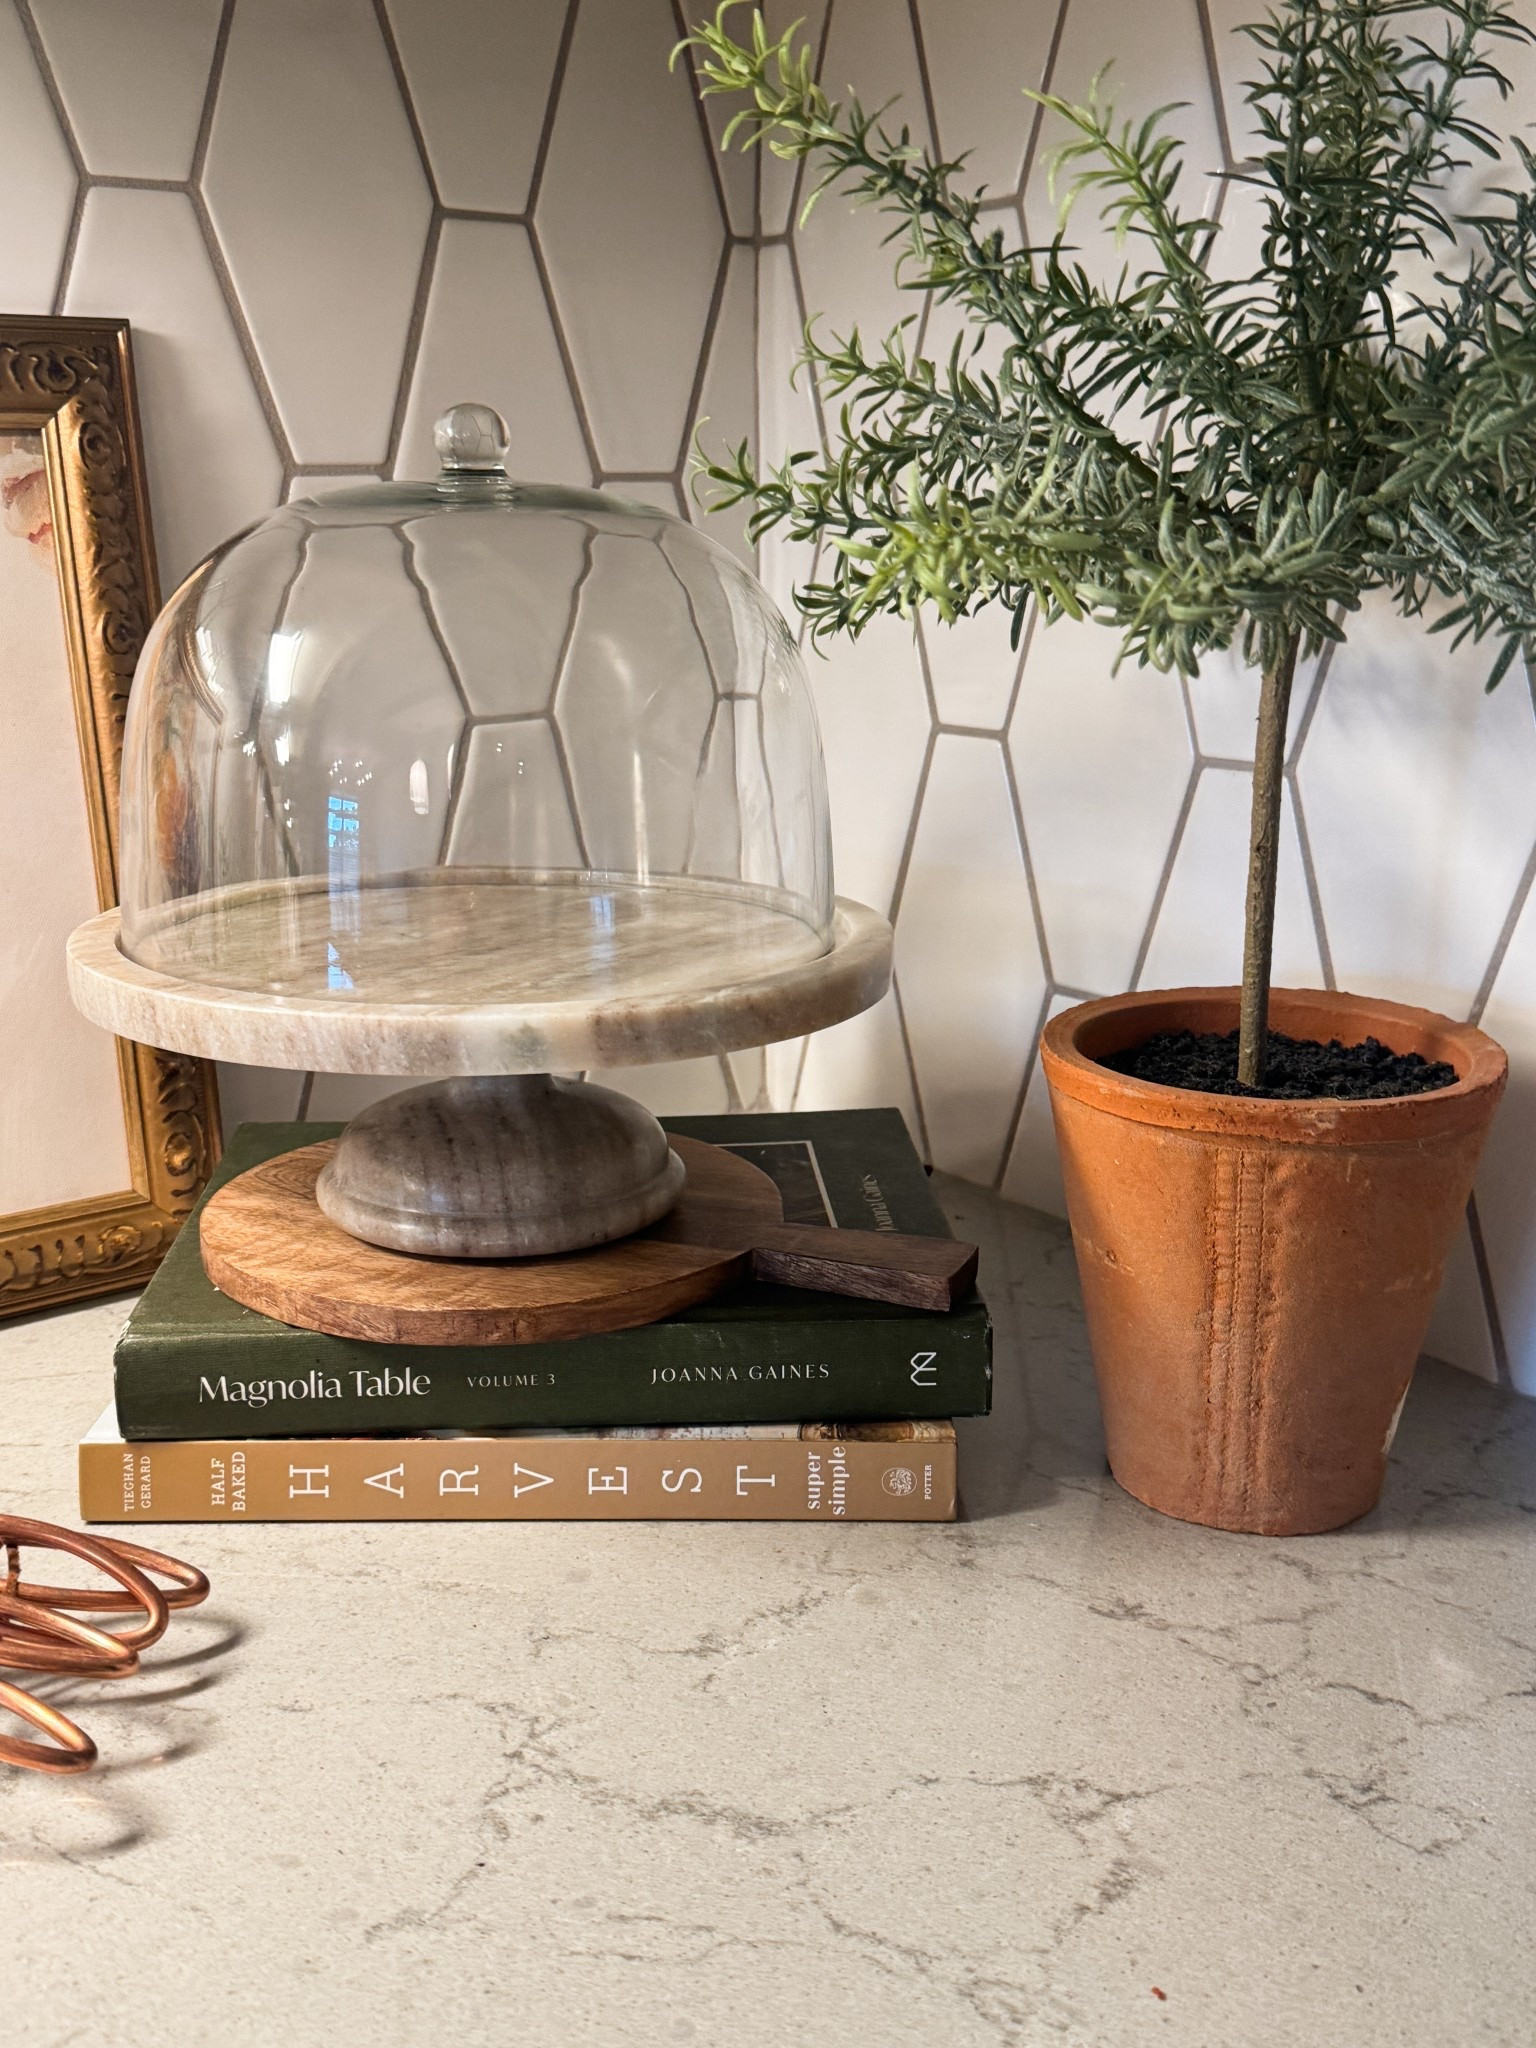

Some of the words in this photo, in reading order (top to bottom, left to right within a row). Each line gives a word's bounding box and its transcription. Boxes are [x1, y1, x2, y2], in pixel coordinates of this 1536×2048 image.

[199, 1370, 342, 1408] Magnolia
[349, 1366, 431, 1397] Table
[467, 1374, 539, 1388] VOLUME
[547, 1373, 556, 1385] 3
[651, 1366, 738, 1385] JOANNA
[748, 1363, 831, 1380] GAINES
[123, 1453, 135, 1512] TIEGHAN
[140, 1455, 152, 1509] GERARD
[211, 1457, 226, 1506] HALF
[232, 1451, 246, 1512] BAKED
[807, 1451, 825, 1510] super
[827, 1446, 850, 1516] simple
[924, 1464, 932, 1500] POTTER
